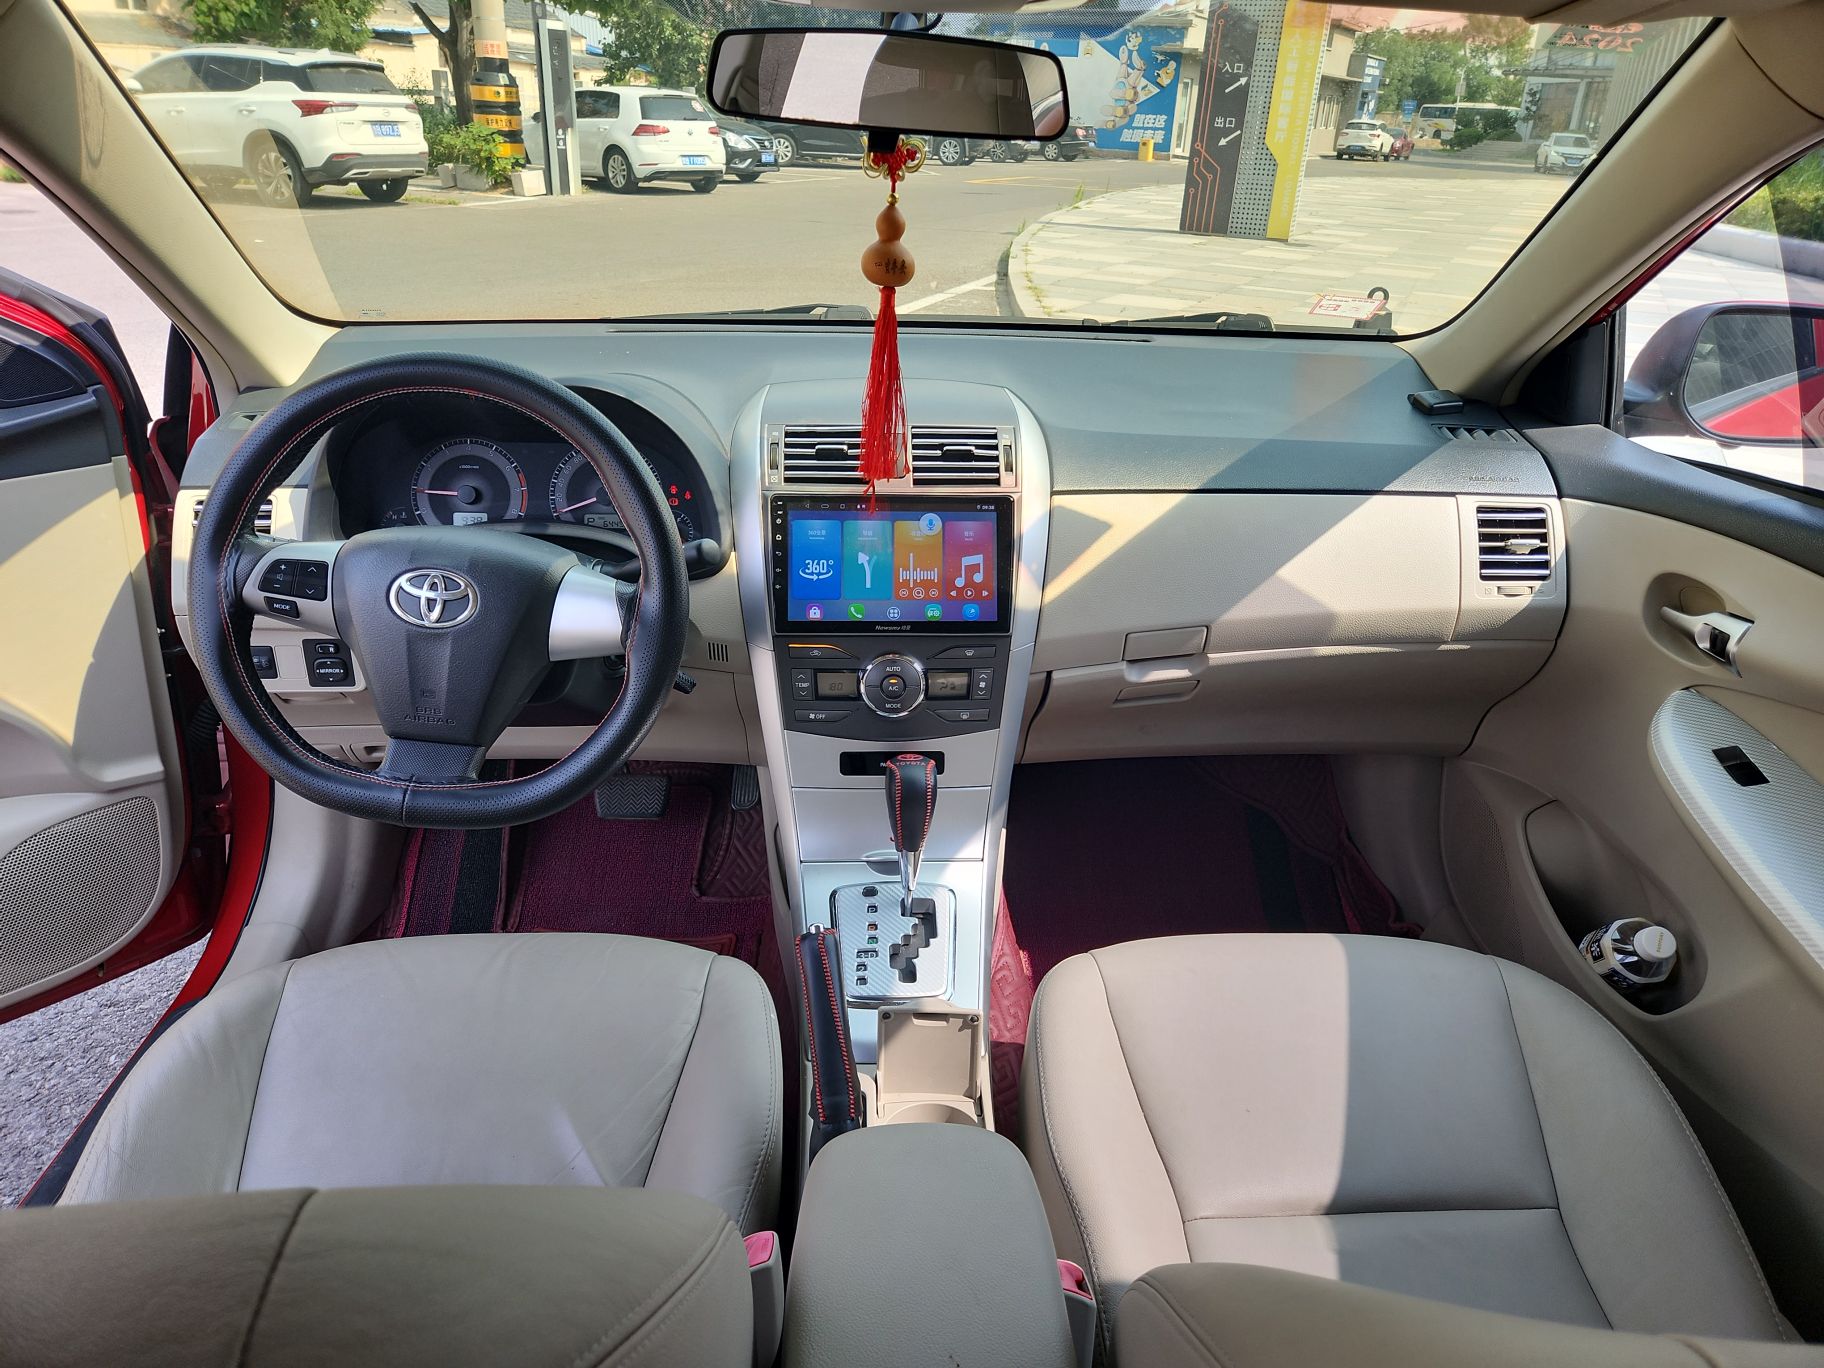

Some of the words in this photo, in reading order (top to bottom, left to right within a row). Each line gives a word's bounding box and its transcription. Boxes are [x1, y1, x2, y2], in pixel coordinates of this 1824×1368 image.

[1222, 62, 1243, 74] 入口
[1214, 117, 1235, 129] 出口
[556, 493, 563, 502] 20
[586, 517, 595, 525] P
[404, 715, 456, 726] AIRBAG
